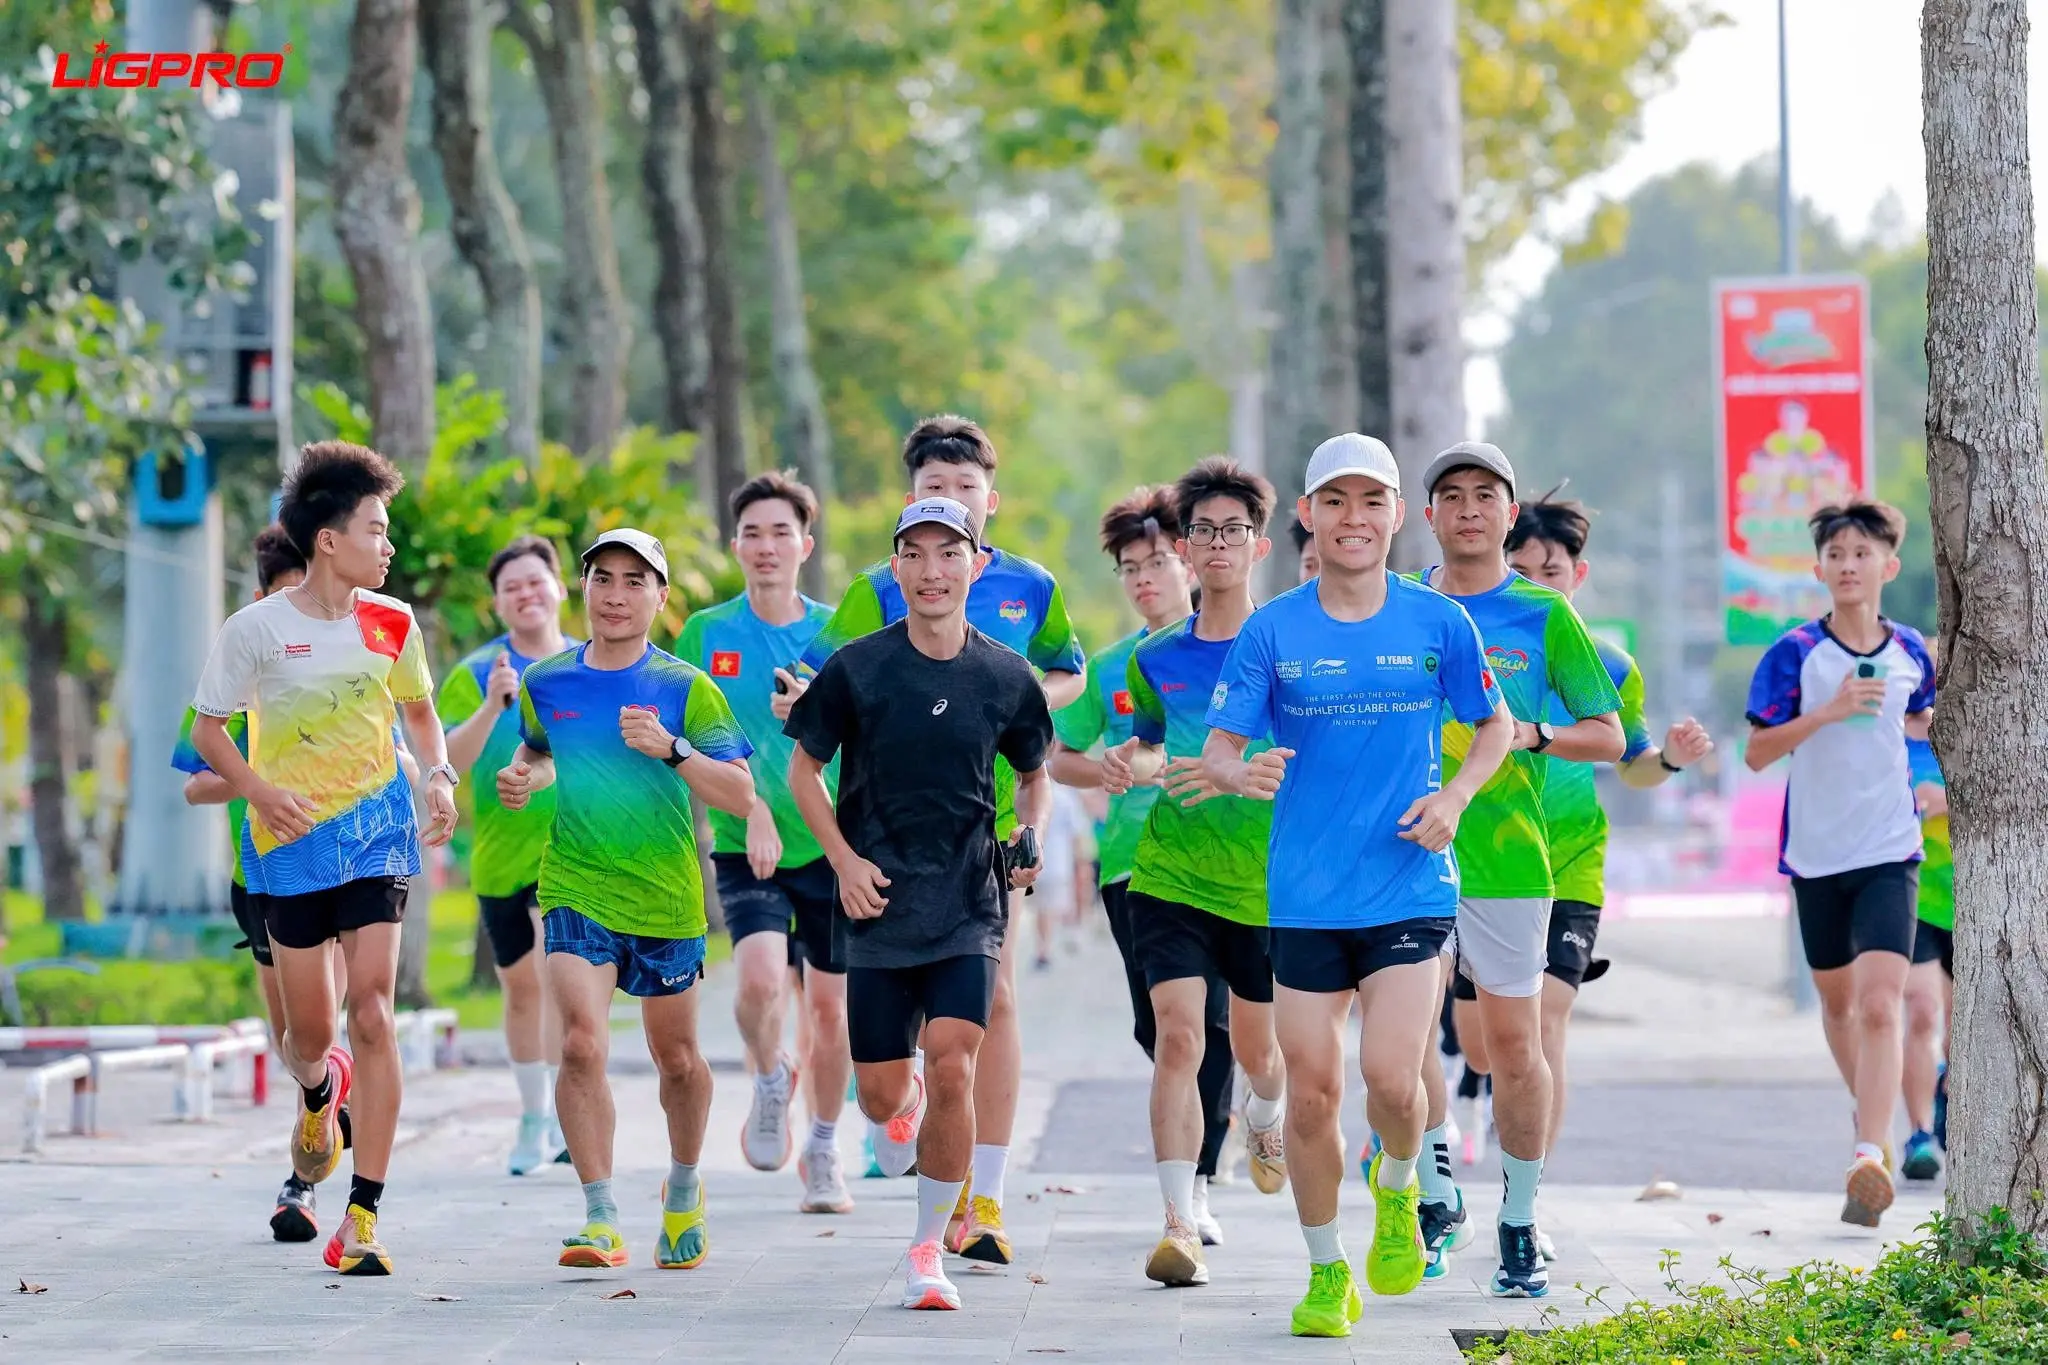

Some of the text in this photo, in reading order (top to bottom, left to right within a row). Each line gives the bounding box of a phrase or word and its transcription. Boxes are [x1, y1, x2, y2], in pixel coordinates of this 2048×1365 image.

[1376, 655, 1413, 665] 10 YEARS
[1312, 668, 1347, 677] LI-NING
[1305, 704, 1355, 717] ATHLETICS
[1358, 703, 1389, 713] LABEL
[1392, 702, 1419, 713] ROAD
[1419, 698, 1433, 710] RACE
